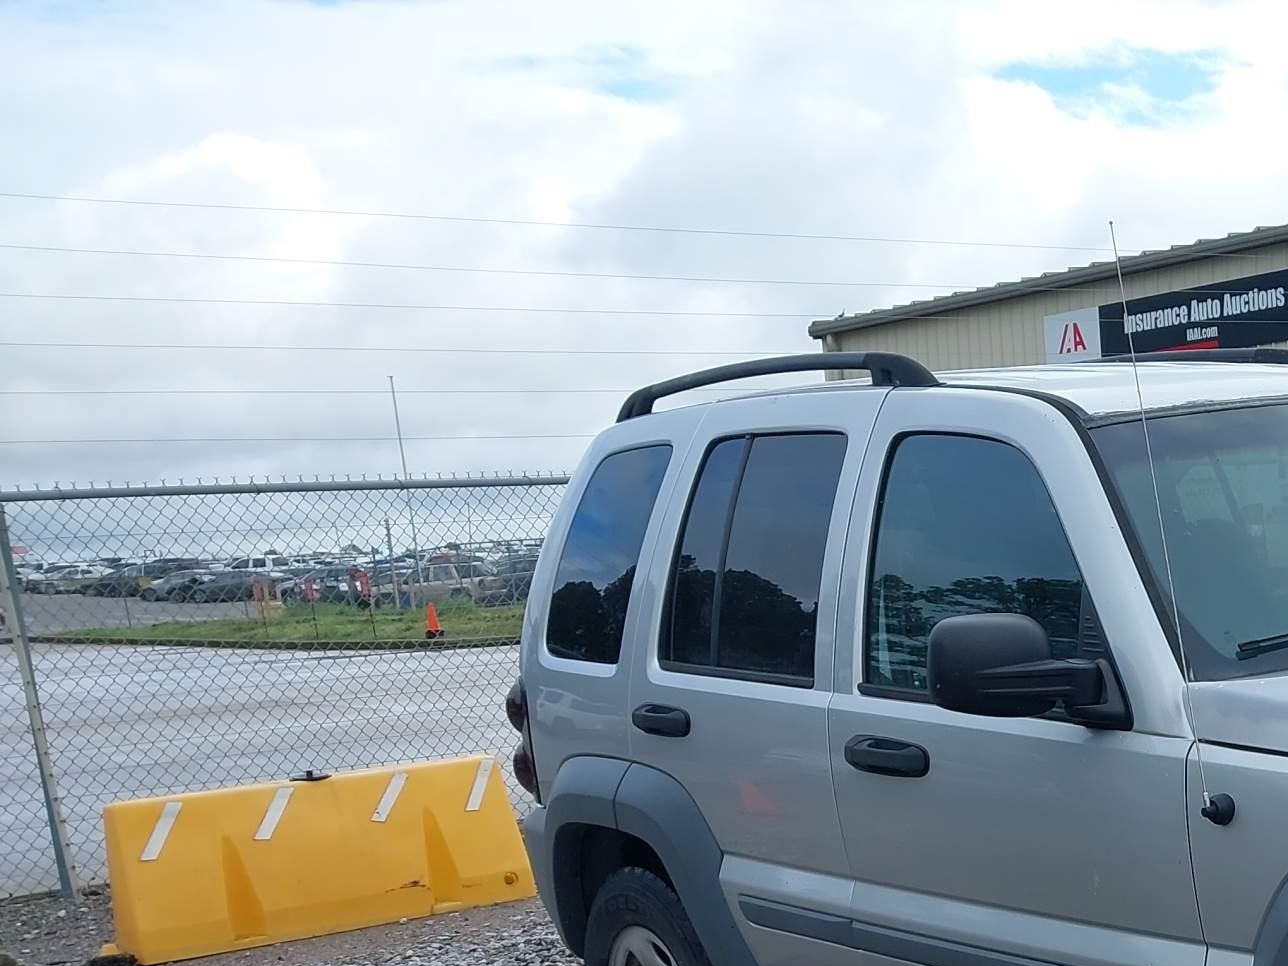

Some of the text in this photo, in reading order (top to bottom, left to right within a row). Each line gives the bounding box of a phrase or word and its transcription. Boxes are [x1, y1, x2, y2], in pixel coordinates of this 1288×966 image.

[1123, 287, 1285, 334] Insurance Auto Auctions
[1186, 325, 1219, 342] IAAI.com
